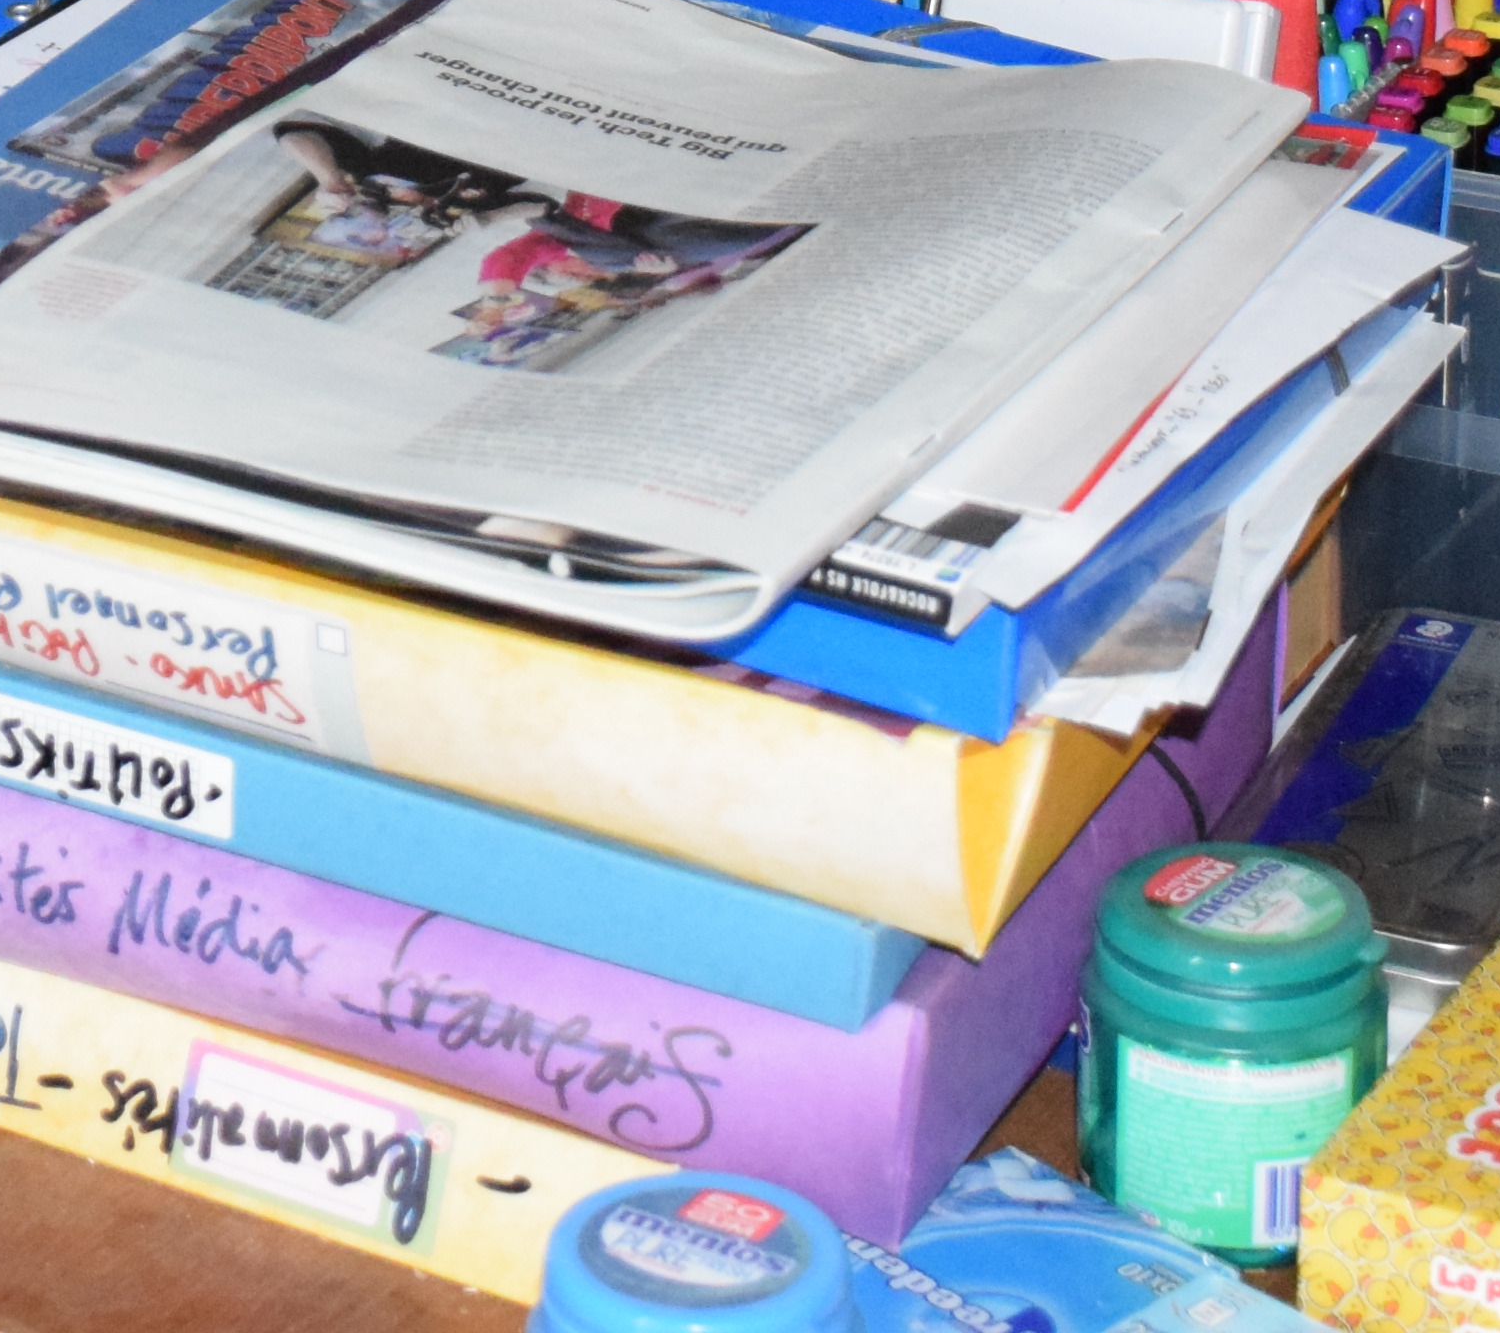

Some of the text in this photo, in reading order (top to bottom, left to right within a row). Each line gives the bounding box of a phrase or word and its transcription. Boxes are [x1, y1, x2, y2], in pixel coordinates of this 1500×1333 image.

[413, 47, 556, 104] changer
[436, 66, 554, 115] procès
[620, 101, 739, 149] peuvent
[681, 133, 734, 161] Big
[1166, 862, 1236, 905] GUM
[1179, 857, 1288, 927] mentos
[106, 864, 312, 978] Média
[613, 1204, 797, 1275] mentos
[1436, 1261, 1478, 1293] Le
